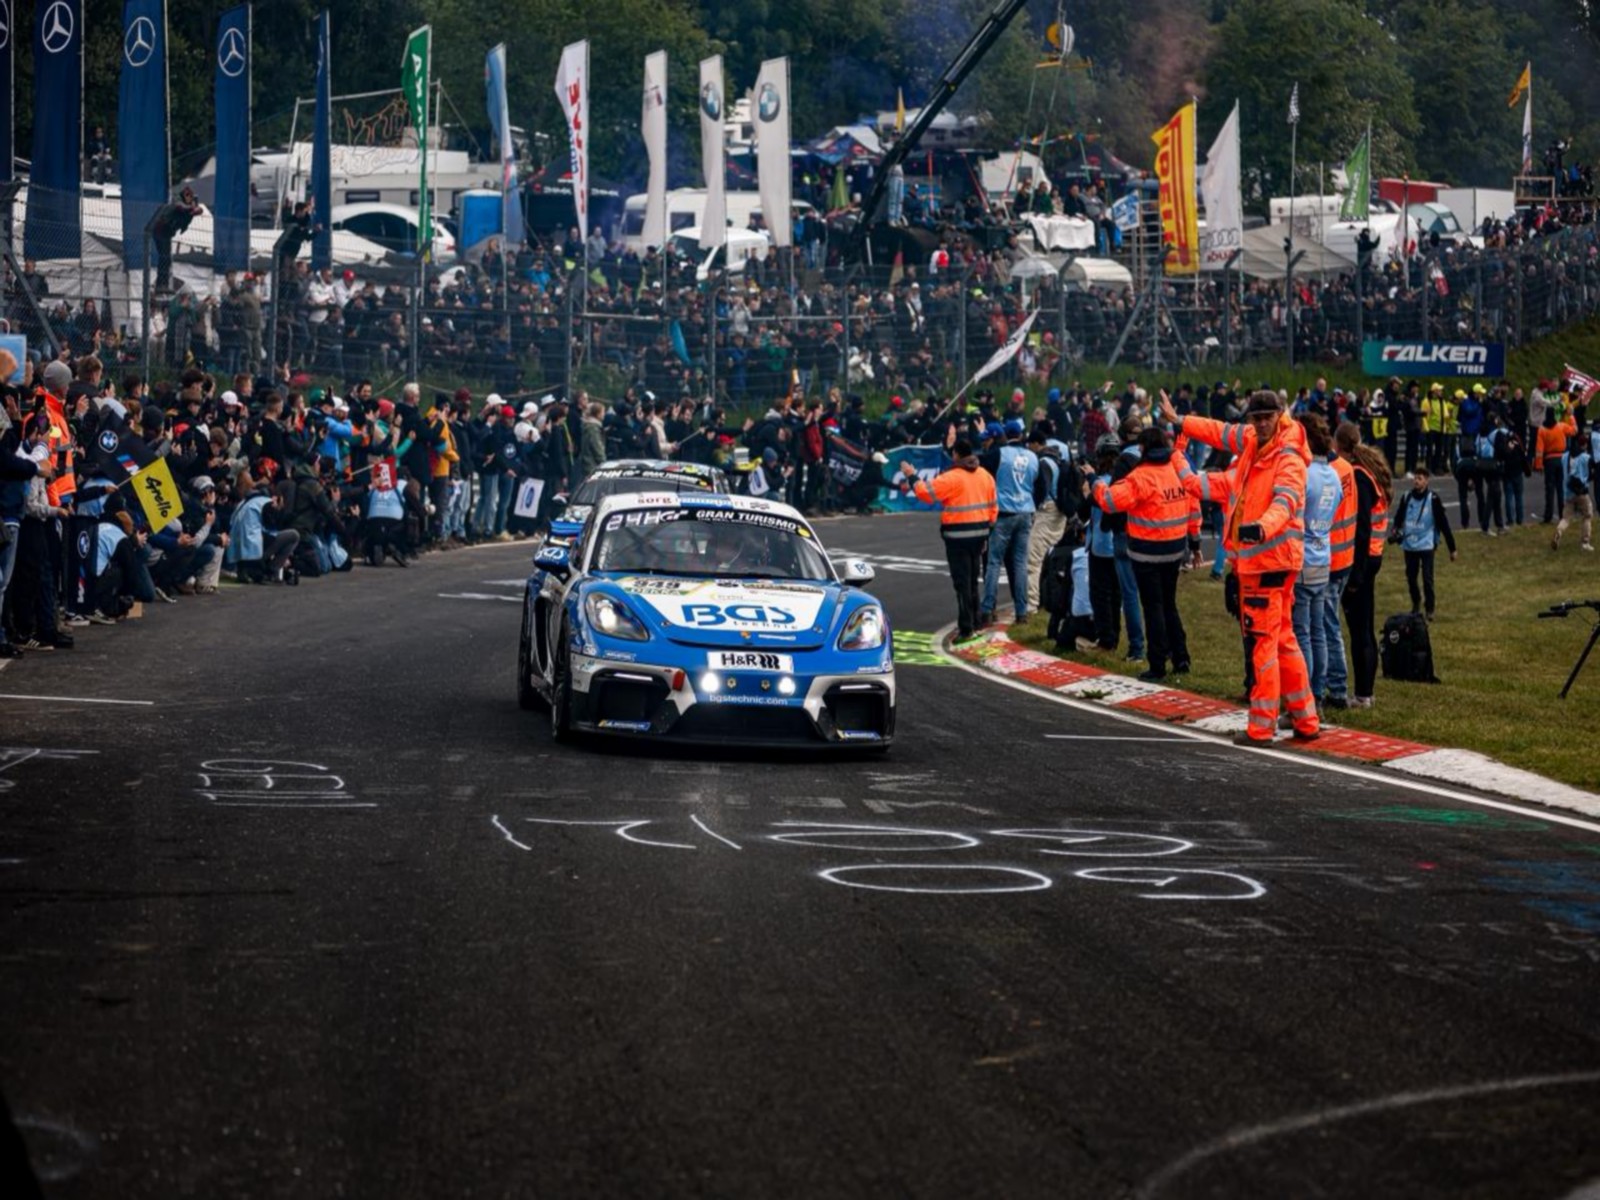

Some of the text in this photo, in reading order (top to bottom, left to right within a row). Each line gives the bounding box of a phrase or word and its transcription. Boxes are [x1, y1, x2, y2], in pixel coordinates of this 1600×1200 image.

[1382, 345, 1488, 363] FALKEN
[1457, 364, 1485, 375] TYRES
[145, 476, 172, 518] Grello
[1163, 487, 1186, 500] VLN
[606, 511, 661, 532] 24H
[696, 510, 735, 519] GRAN
[738, 512, 799, 531] TURISMO
[681, 604, 796, 626] BGS
[721, 653, 758, 666] H&R
[709, 695, 788, 706] bgstechnic.com
